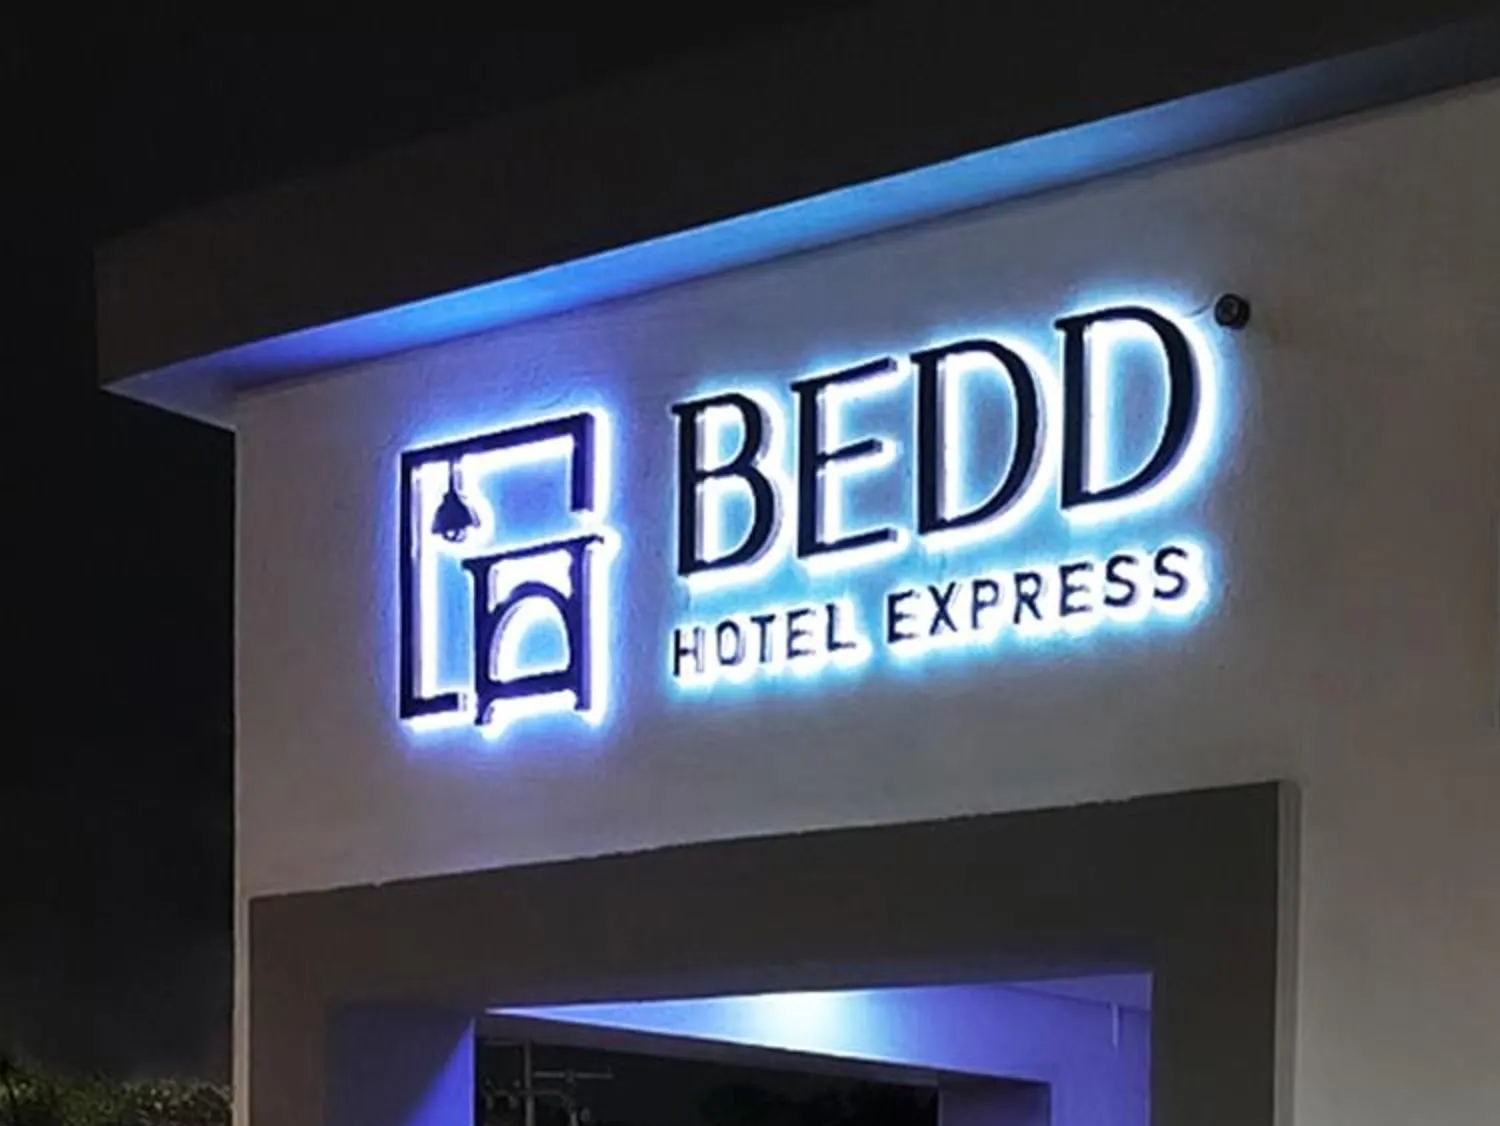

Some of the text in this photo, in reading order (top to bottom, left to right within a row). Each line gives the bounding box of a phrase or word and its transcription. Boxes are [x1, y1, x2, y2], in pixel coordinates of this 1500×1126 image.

[671, 305, 1201, 577] BEDD
[673, 546, 1190, 677] HOTEL EXPRESS
